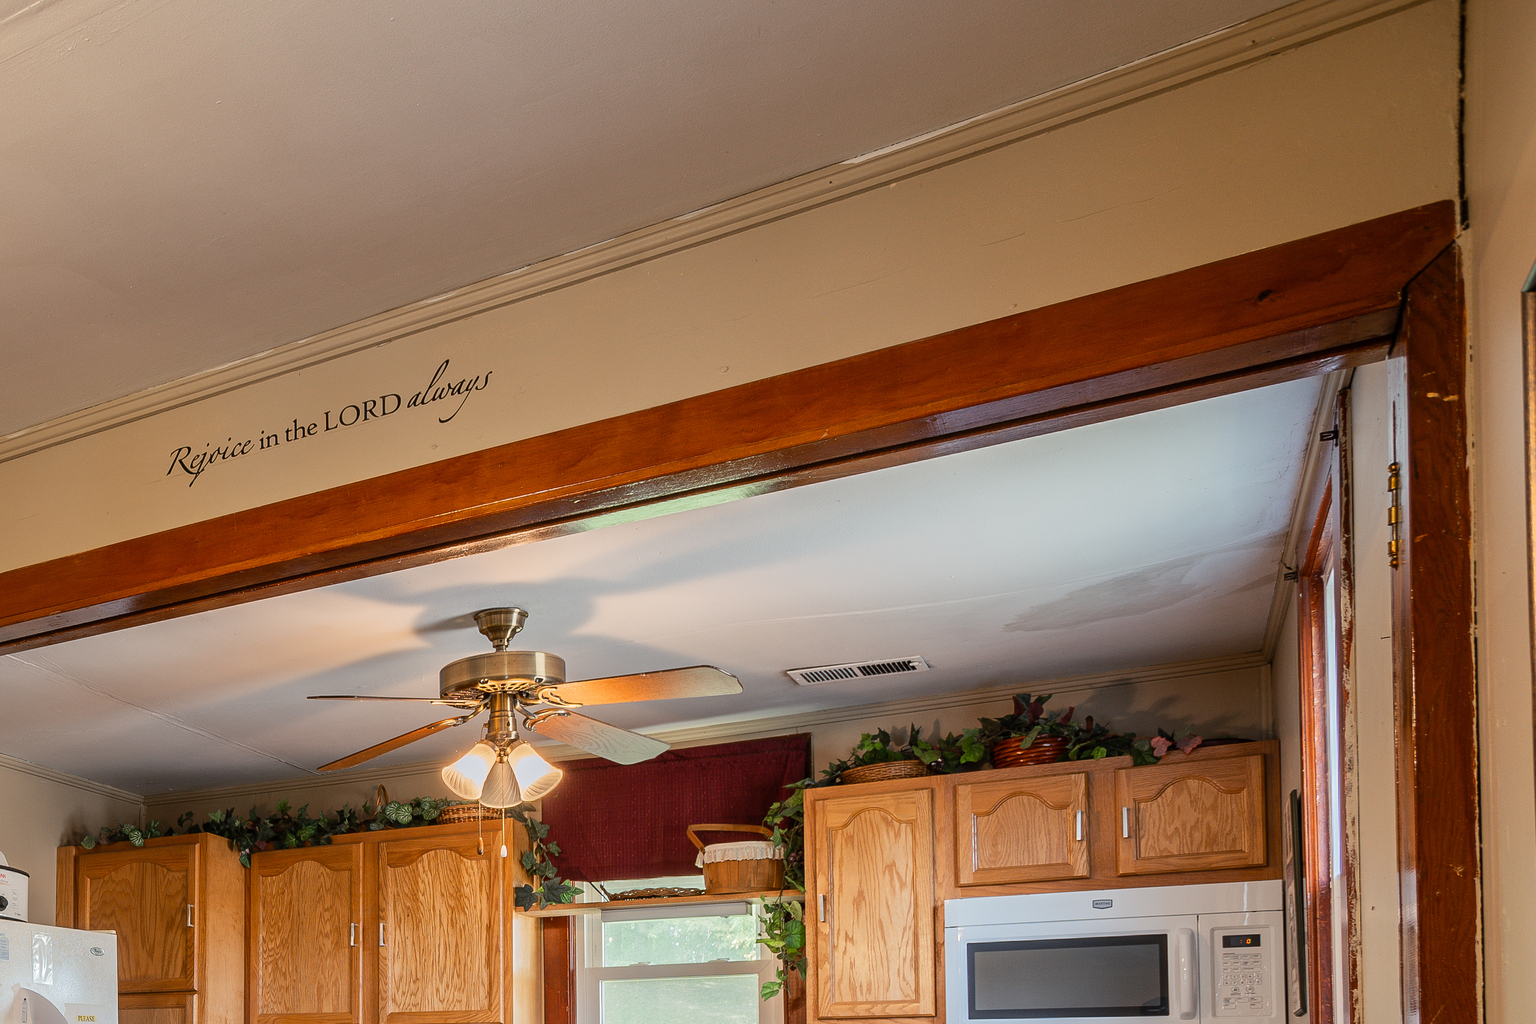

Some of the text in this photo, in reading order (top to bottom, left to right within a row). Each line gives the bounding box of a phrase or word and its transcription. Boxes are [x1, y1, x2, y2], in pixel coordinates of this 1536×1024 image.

[166, 359, 493, 487] Rejoice in the LORD always
